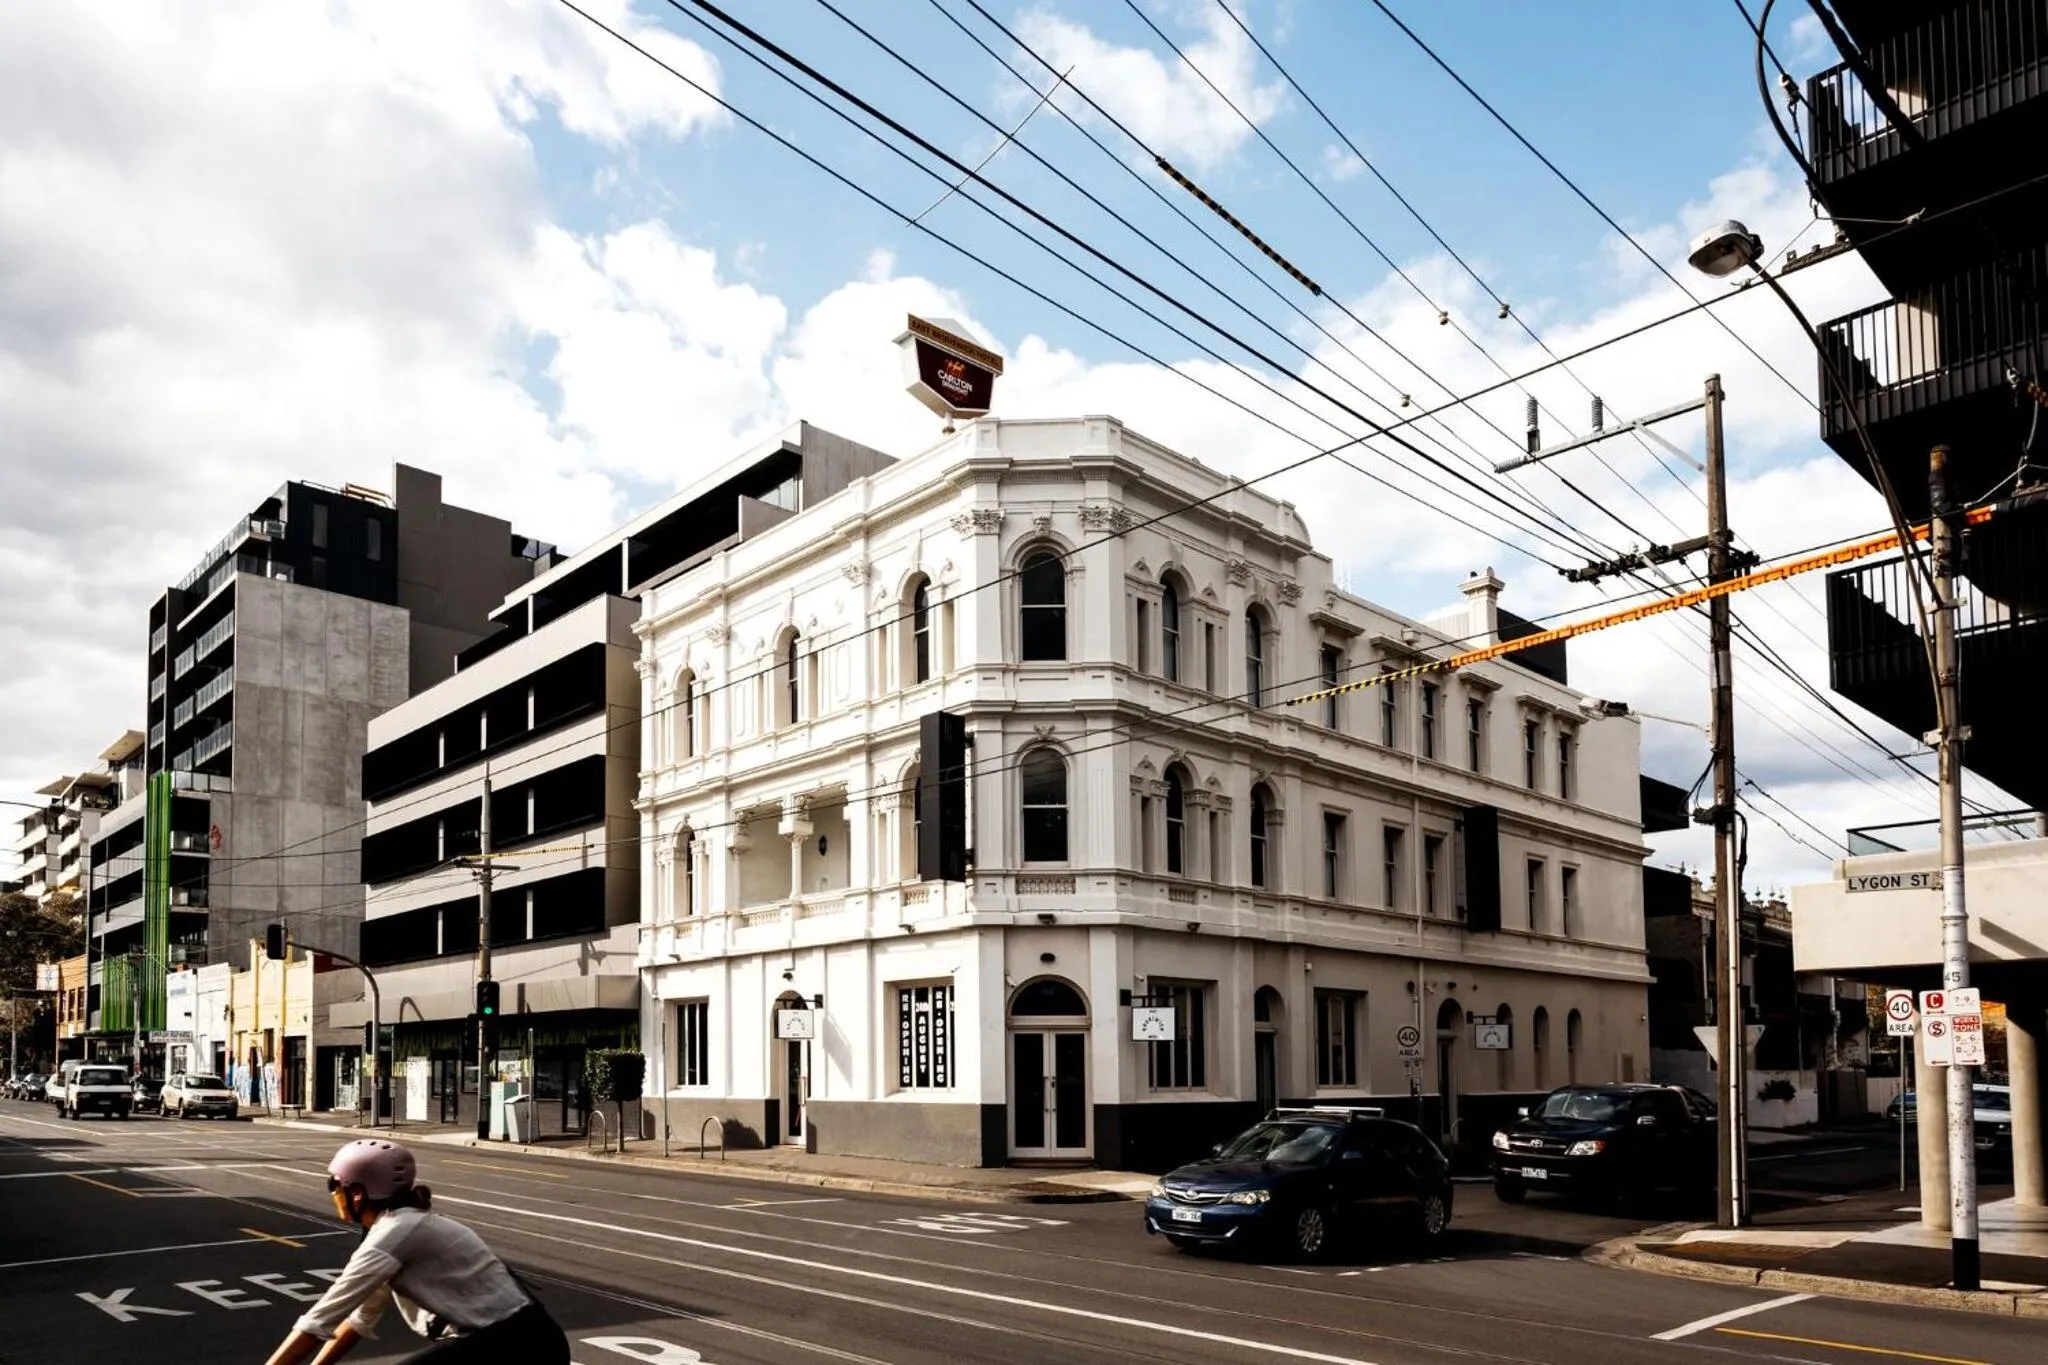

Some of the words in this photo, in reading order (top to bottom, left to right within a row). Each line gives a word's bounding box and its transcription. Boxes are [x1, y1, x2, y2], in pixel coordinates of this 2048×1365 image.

[937, 369, 973, 393] CARLTON
[1848, 875, 1901, 890] LYGON
[1910, 874, 1930, 887] ST
[1892, 1001, 1910, 1014] 40
[1889, 1023, 1915, 1033] AREA
[1953, 1023, 1980, 1032] ZONE
[1401, 1031, 1416, 1042] 40
[918, 1015, 927, 1073] AUGUST
